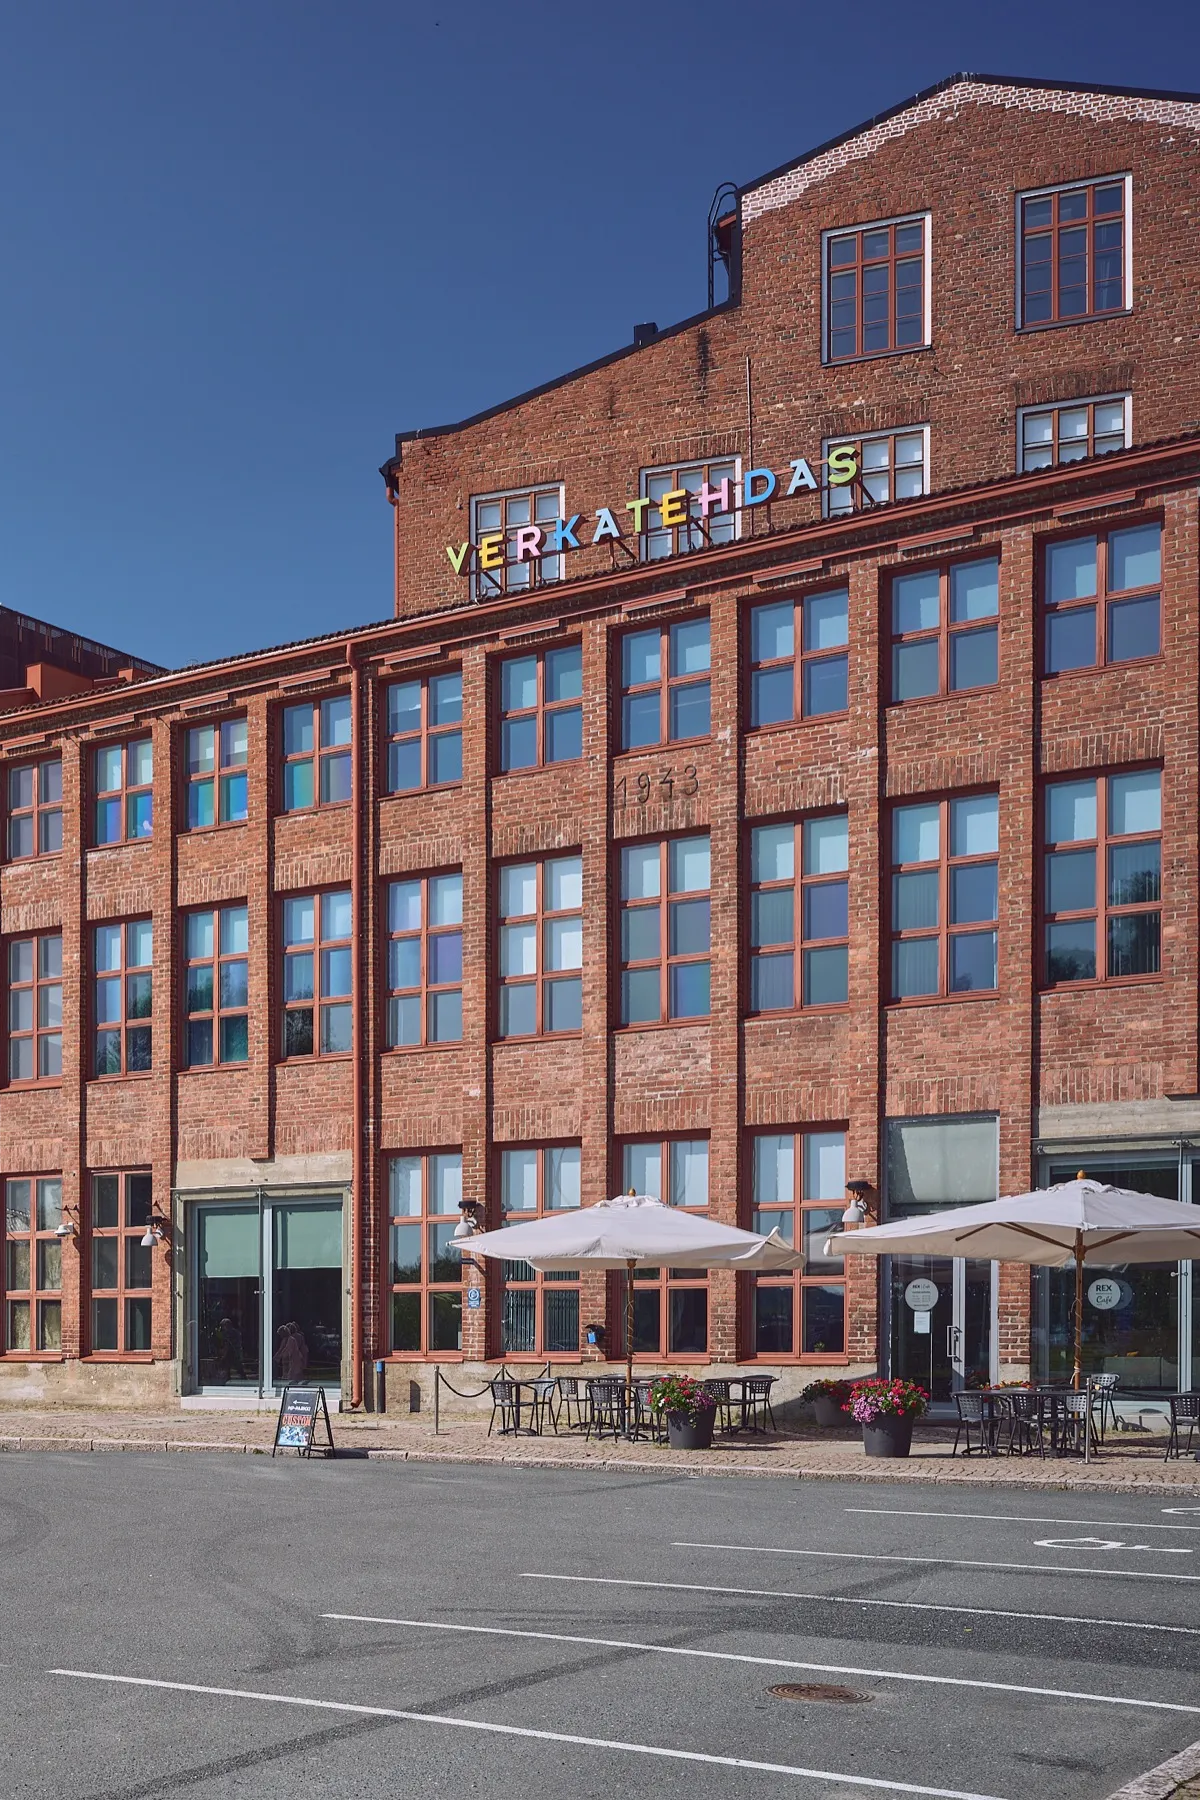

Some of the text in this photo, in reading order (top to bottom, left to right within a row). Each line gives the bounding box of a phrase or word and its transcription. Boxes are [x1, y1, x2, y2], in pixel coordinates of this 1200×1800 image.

[446, 446, 860, 577] VERKATEHDAS
[615, 764, 699, 808] 1943
[1096, 1284, 1112, 1292] REX
[1096, 1295, 1113, 1305] Café
[282, 1415, 312, 1426] CUSTOM
